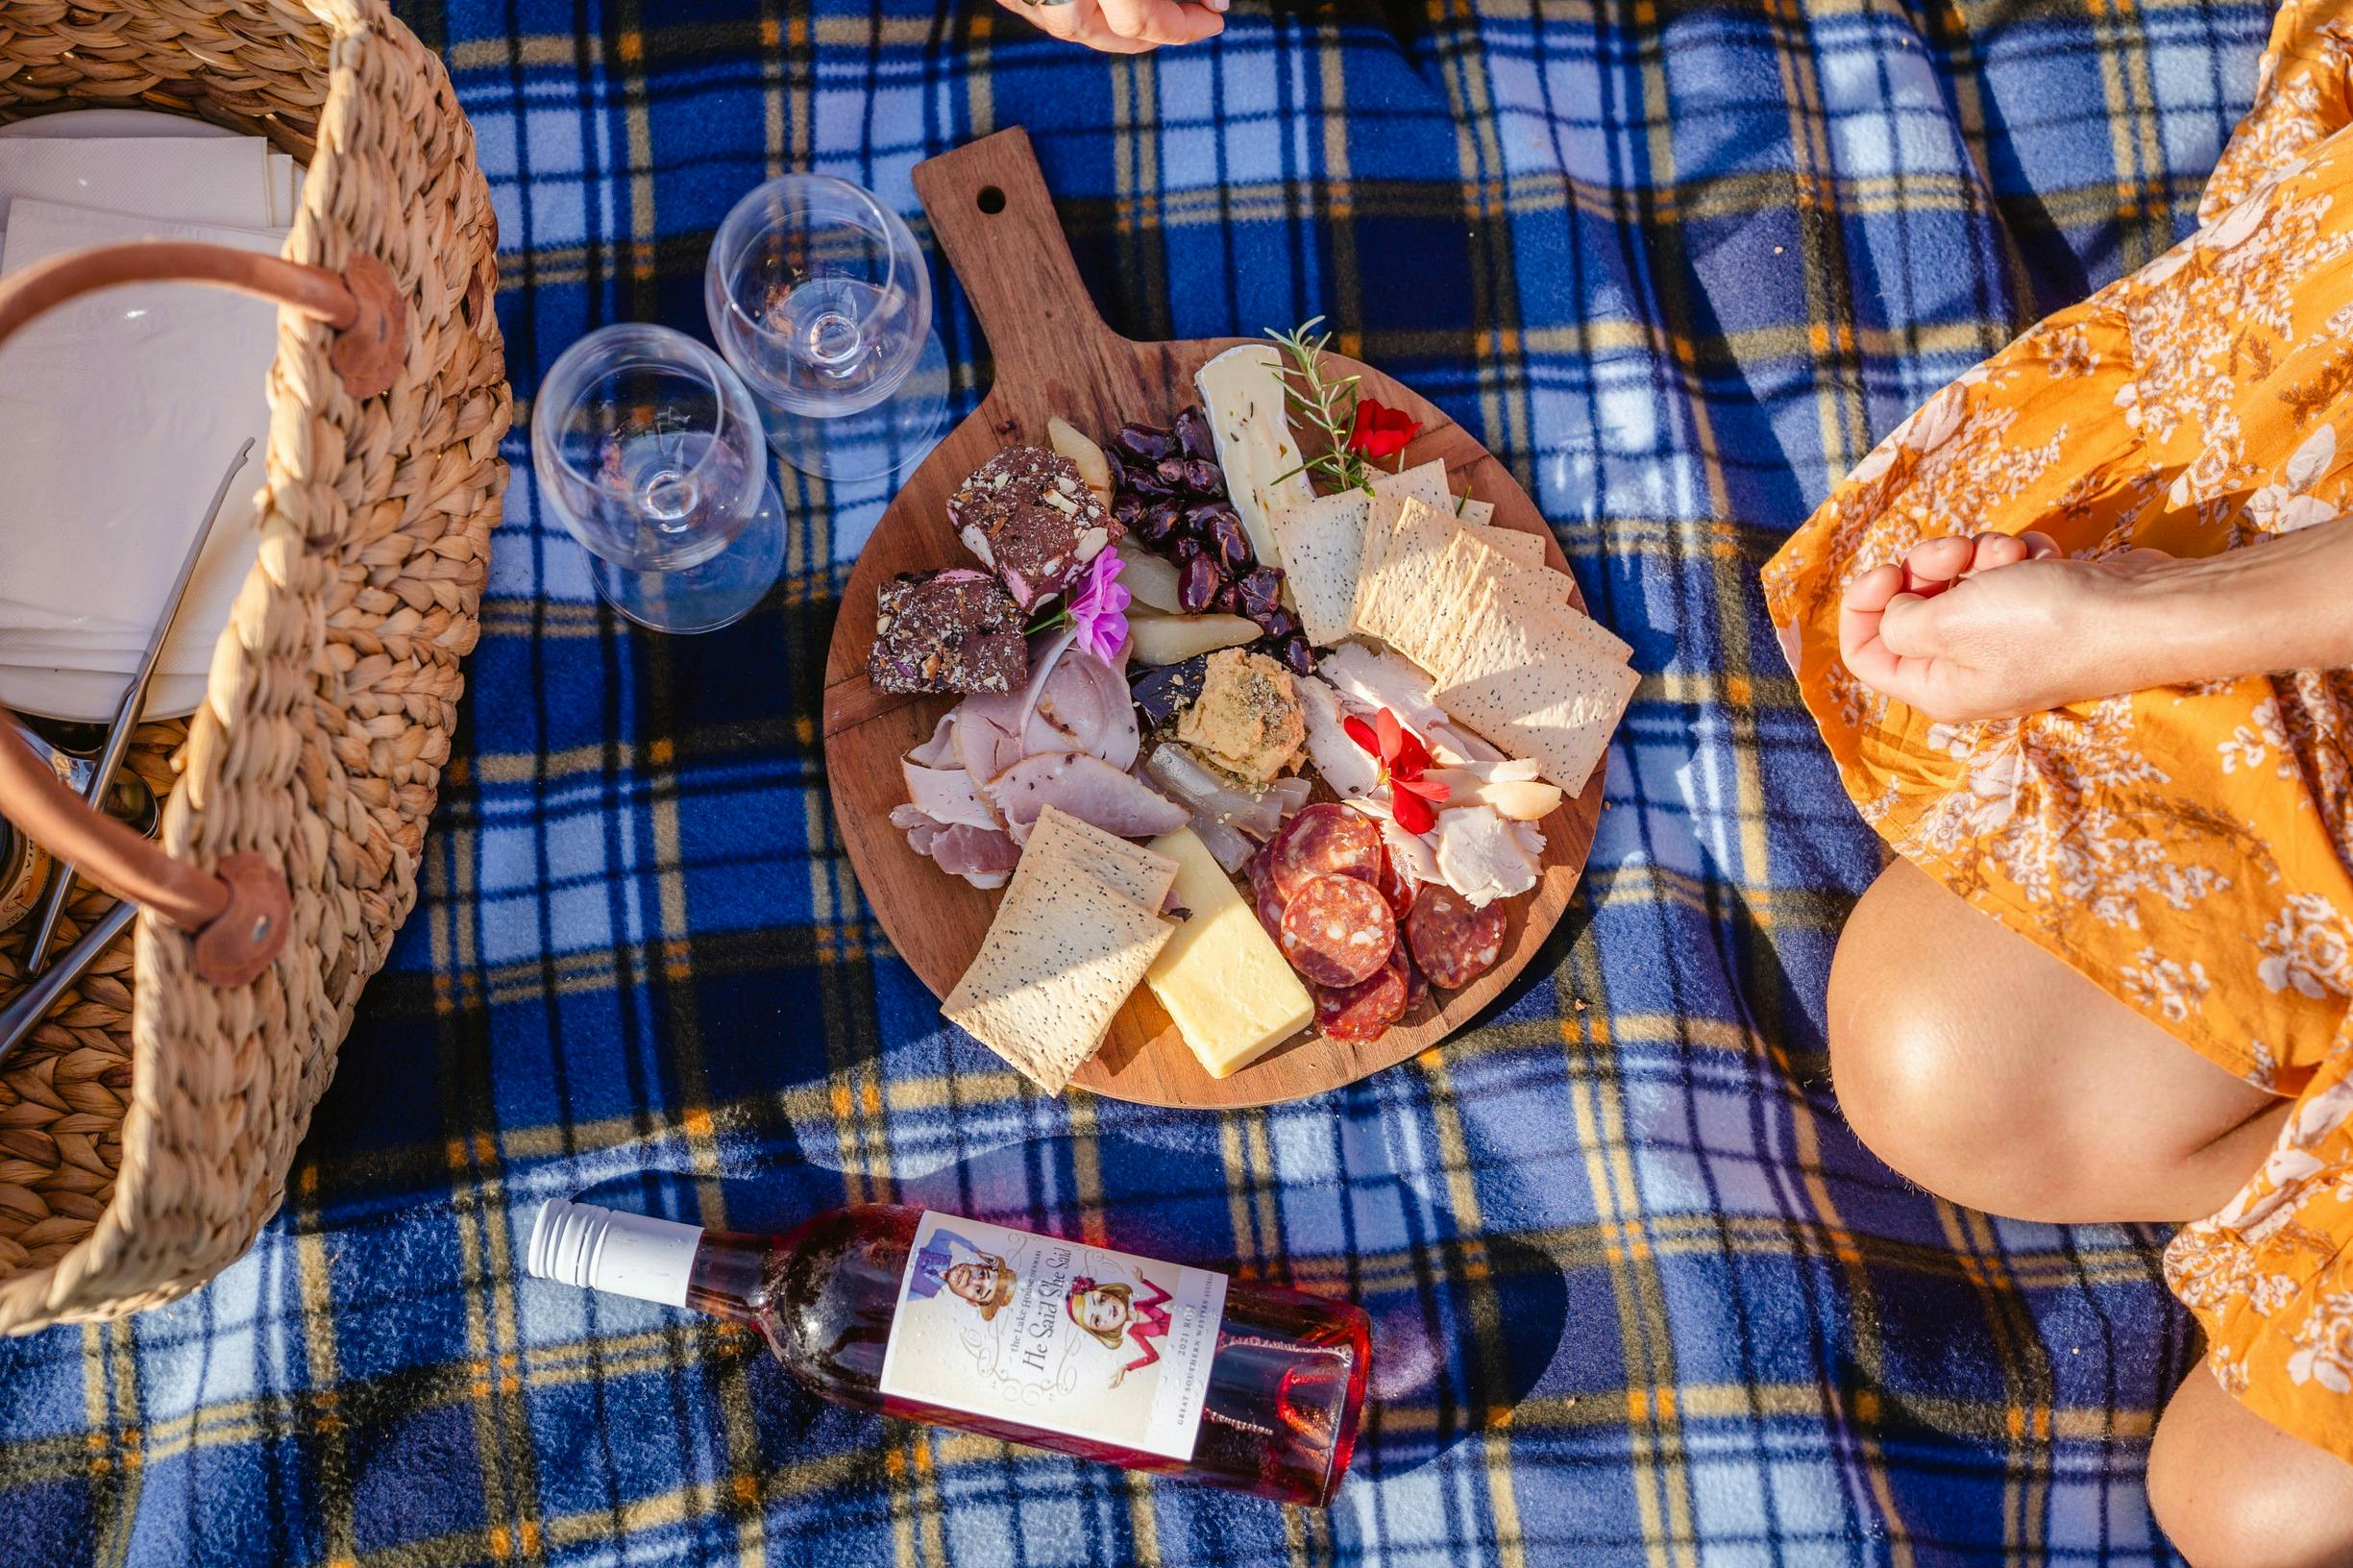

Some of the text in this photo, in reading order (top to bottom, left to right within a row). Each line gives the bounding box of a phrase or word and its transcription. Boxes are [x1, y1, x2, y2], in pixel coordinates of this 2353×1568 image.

[1021, 1277, 1036, 1309] House
[1014, 1310, 1027, 1335] Lake
[1022, 1246, 1072, 1372] He Said She Said
[1010, 1335, 1020, 1352] the
[1178, 1333, 1189, 1356] 2021
[1177, 1395, 1189, 1426] GREAT
[1184, 1340, 1200, 1392] SOUTHERN
[1195, 1299, 1208, 1336] WESTERN
